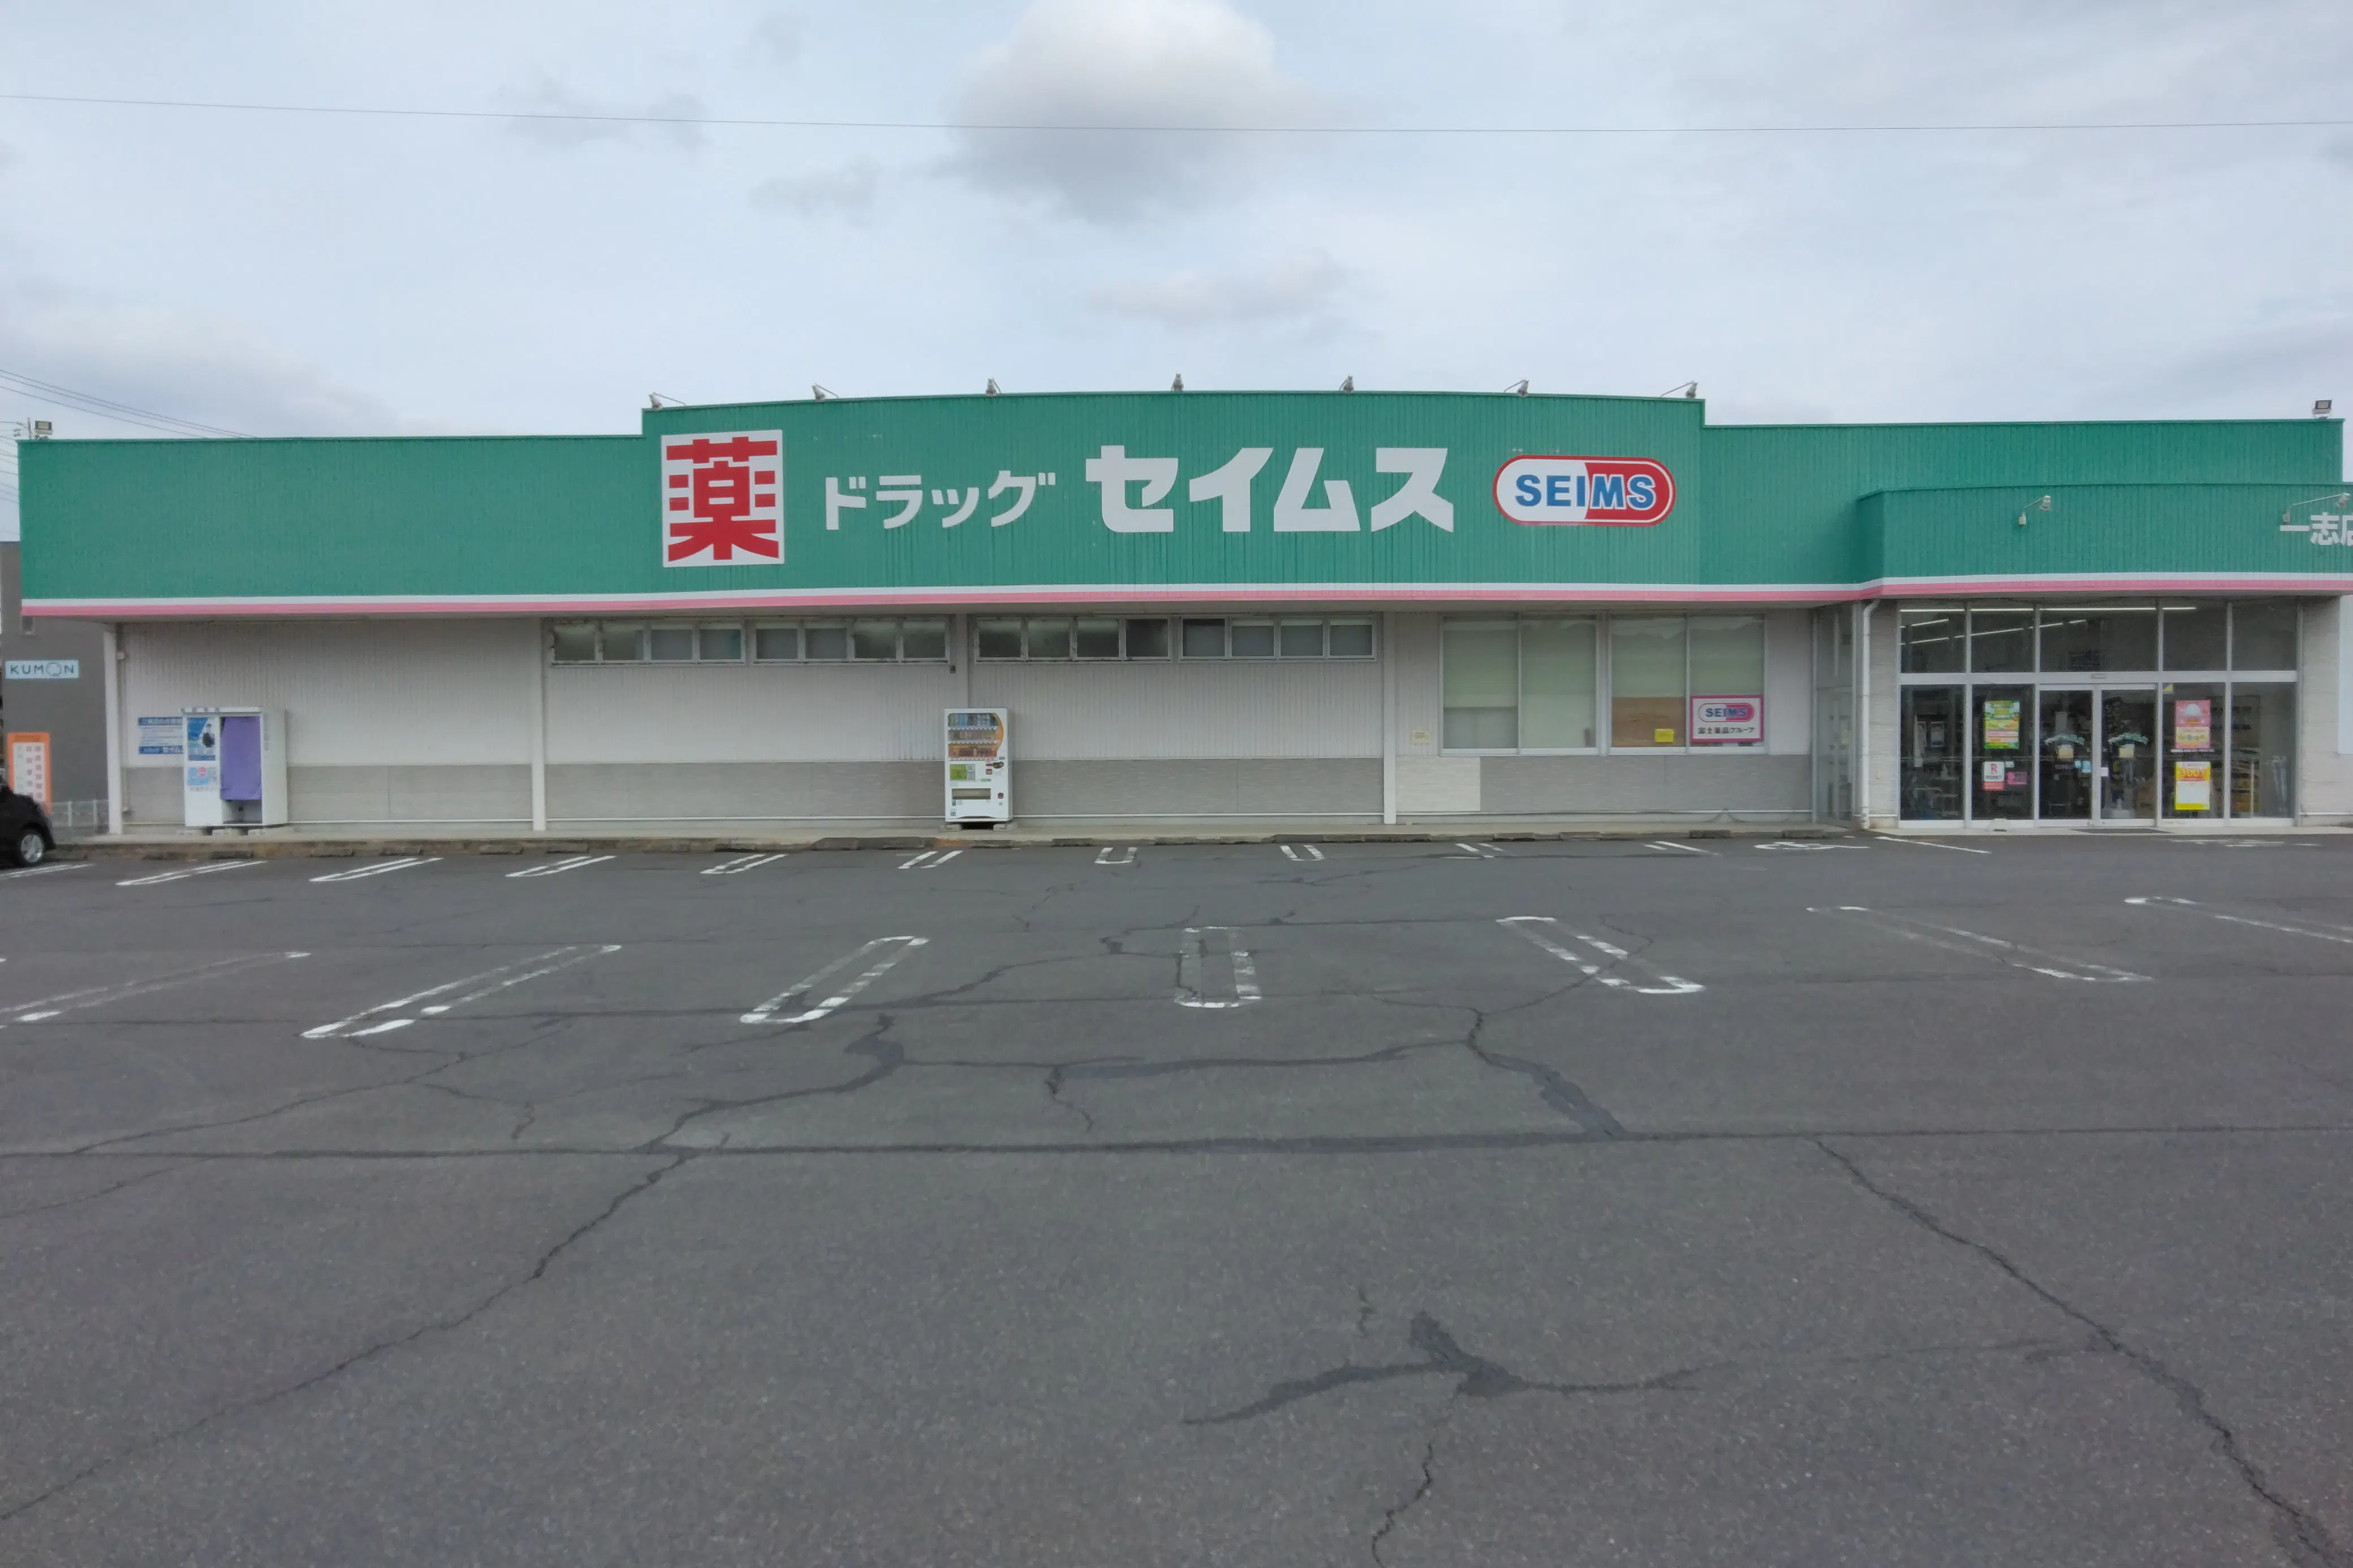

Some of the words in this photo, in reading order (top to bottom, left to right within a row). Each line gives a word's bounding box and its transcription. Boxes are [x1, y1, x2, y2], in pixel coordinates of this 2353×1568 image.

[666, 436, 779, 562] 薬
[825, 469, 1057, 530] ドラッグ
[1085, 444, 1454, 533] セイムス
[1515, 473, 1656, 511] SEIMS
[10, 662, 75, 677] KUMON
